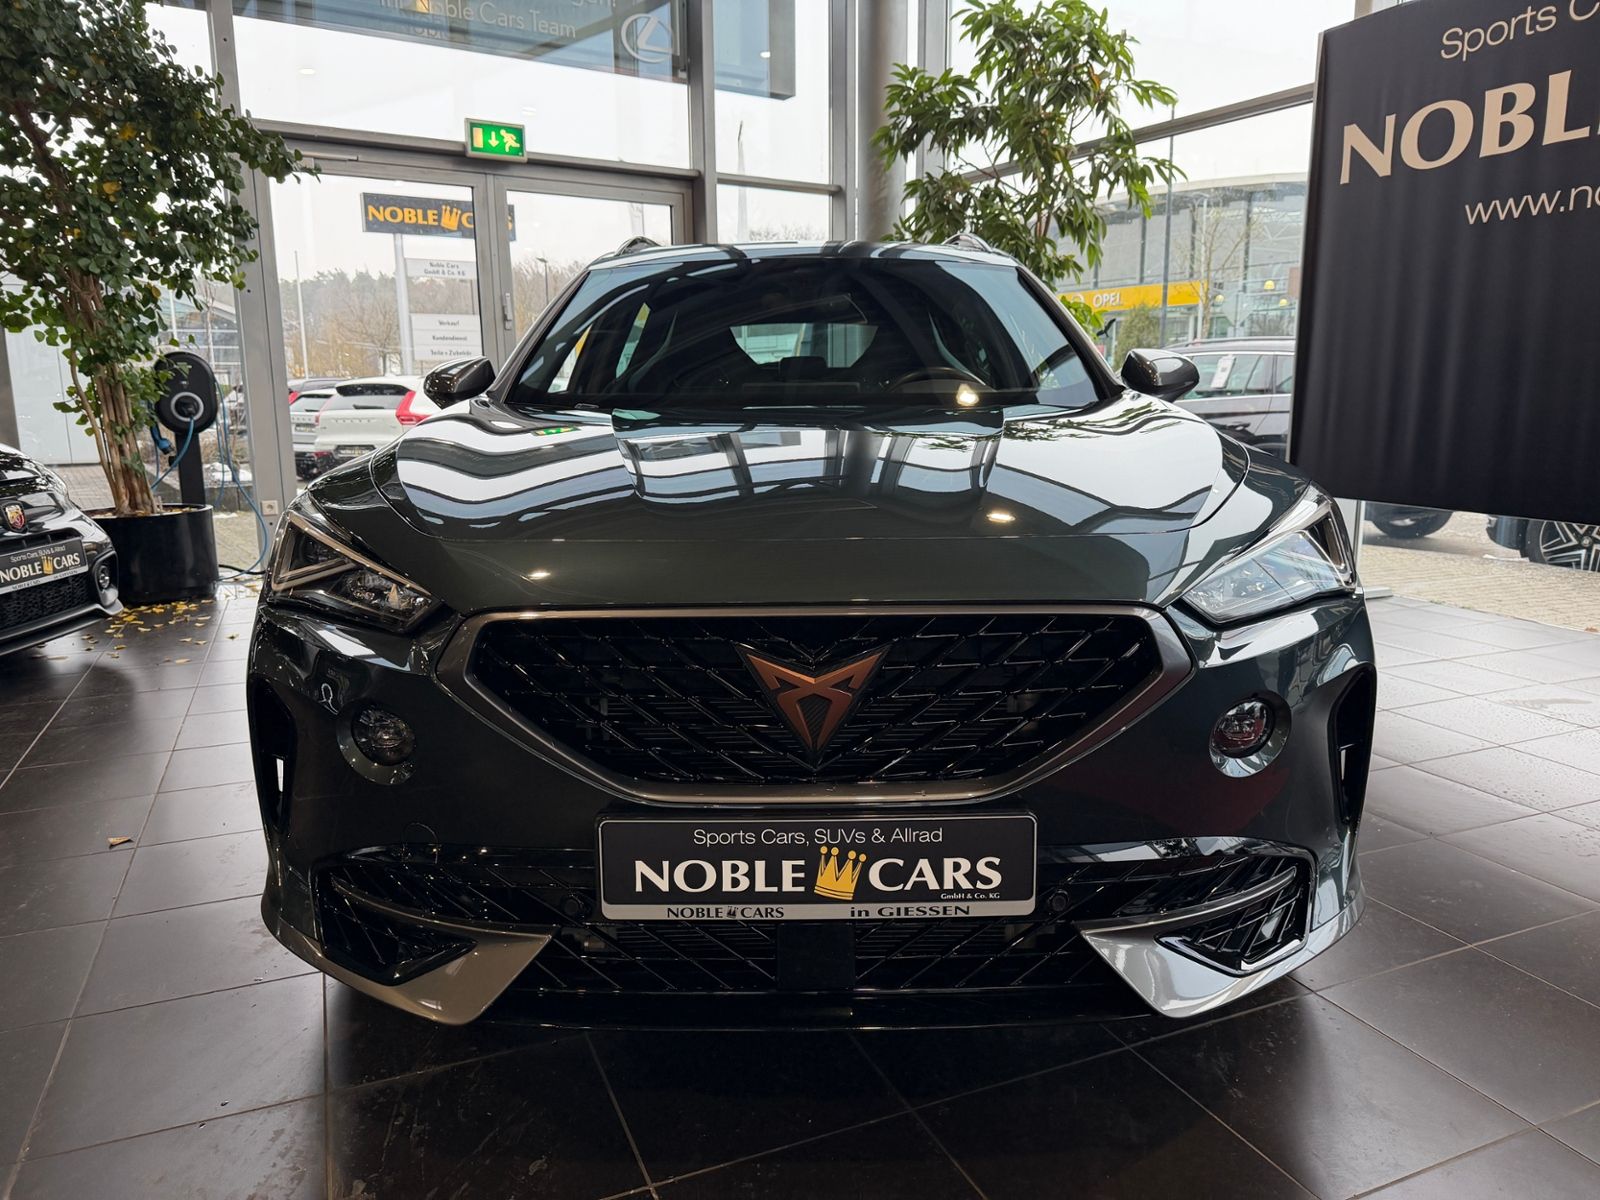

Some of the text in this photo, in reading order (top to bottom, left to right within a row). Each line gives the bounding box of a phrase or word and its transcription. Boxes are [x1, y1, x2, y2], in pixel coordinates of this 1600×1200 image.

[479, 2, 526, 29] Cars
[529, 9, 577, 39] Team
[1440, 6, 1557, 62] Sports
[1339, 69, 1600, 185] NOBL
[367, 204, 439, 226] NOBLE
[1093, 292, 1122, 308] OPEL
[0, 562, 43, 583] NOBLE
[53, 552, 81, 570] CARS
[693, 827, 943, 848] Sports Cars, SUVs & Allrad
[634, 856, 1002, 893] NOBLE CARS
[666, 905, 970, 918] NOBLE CARS in GIESSEN
